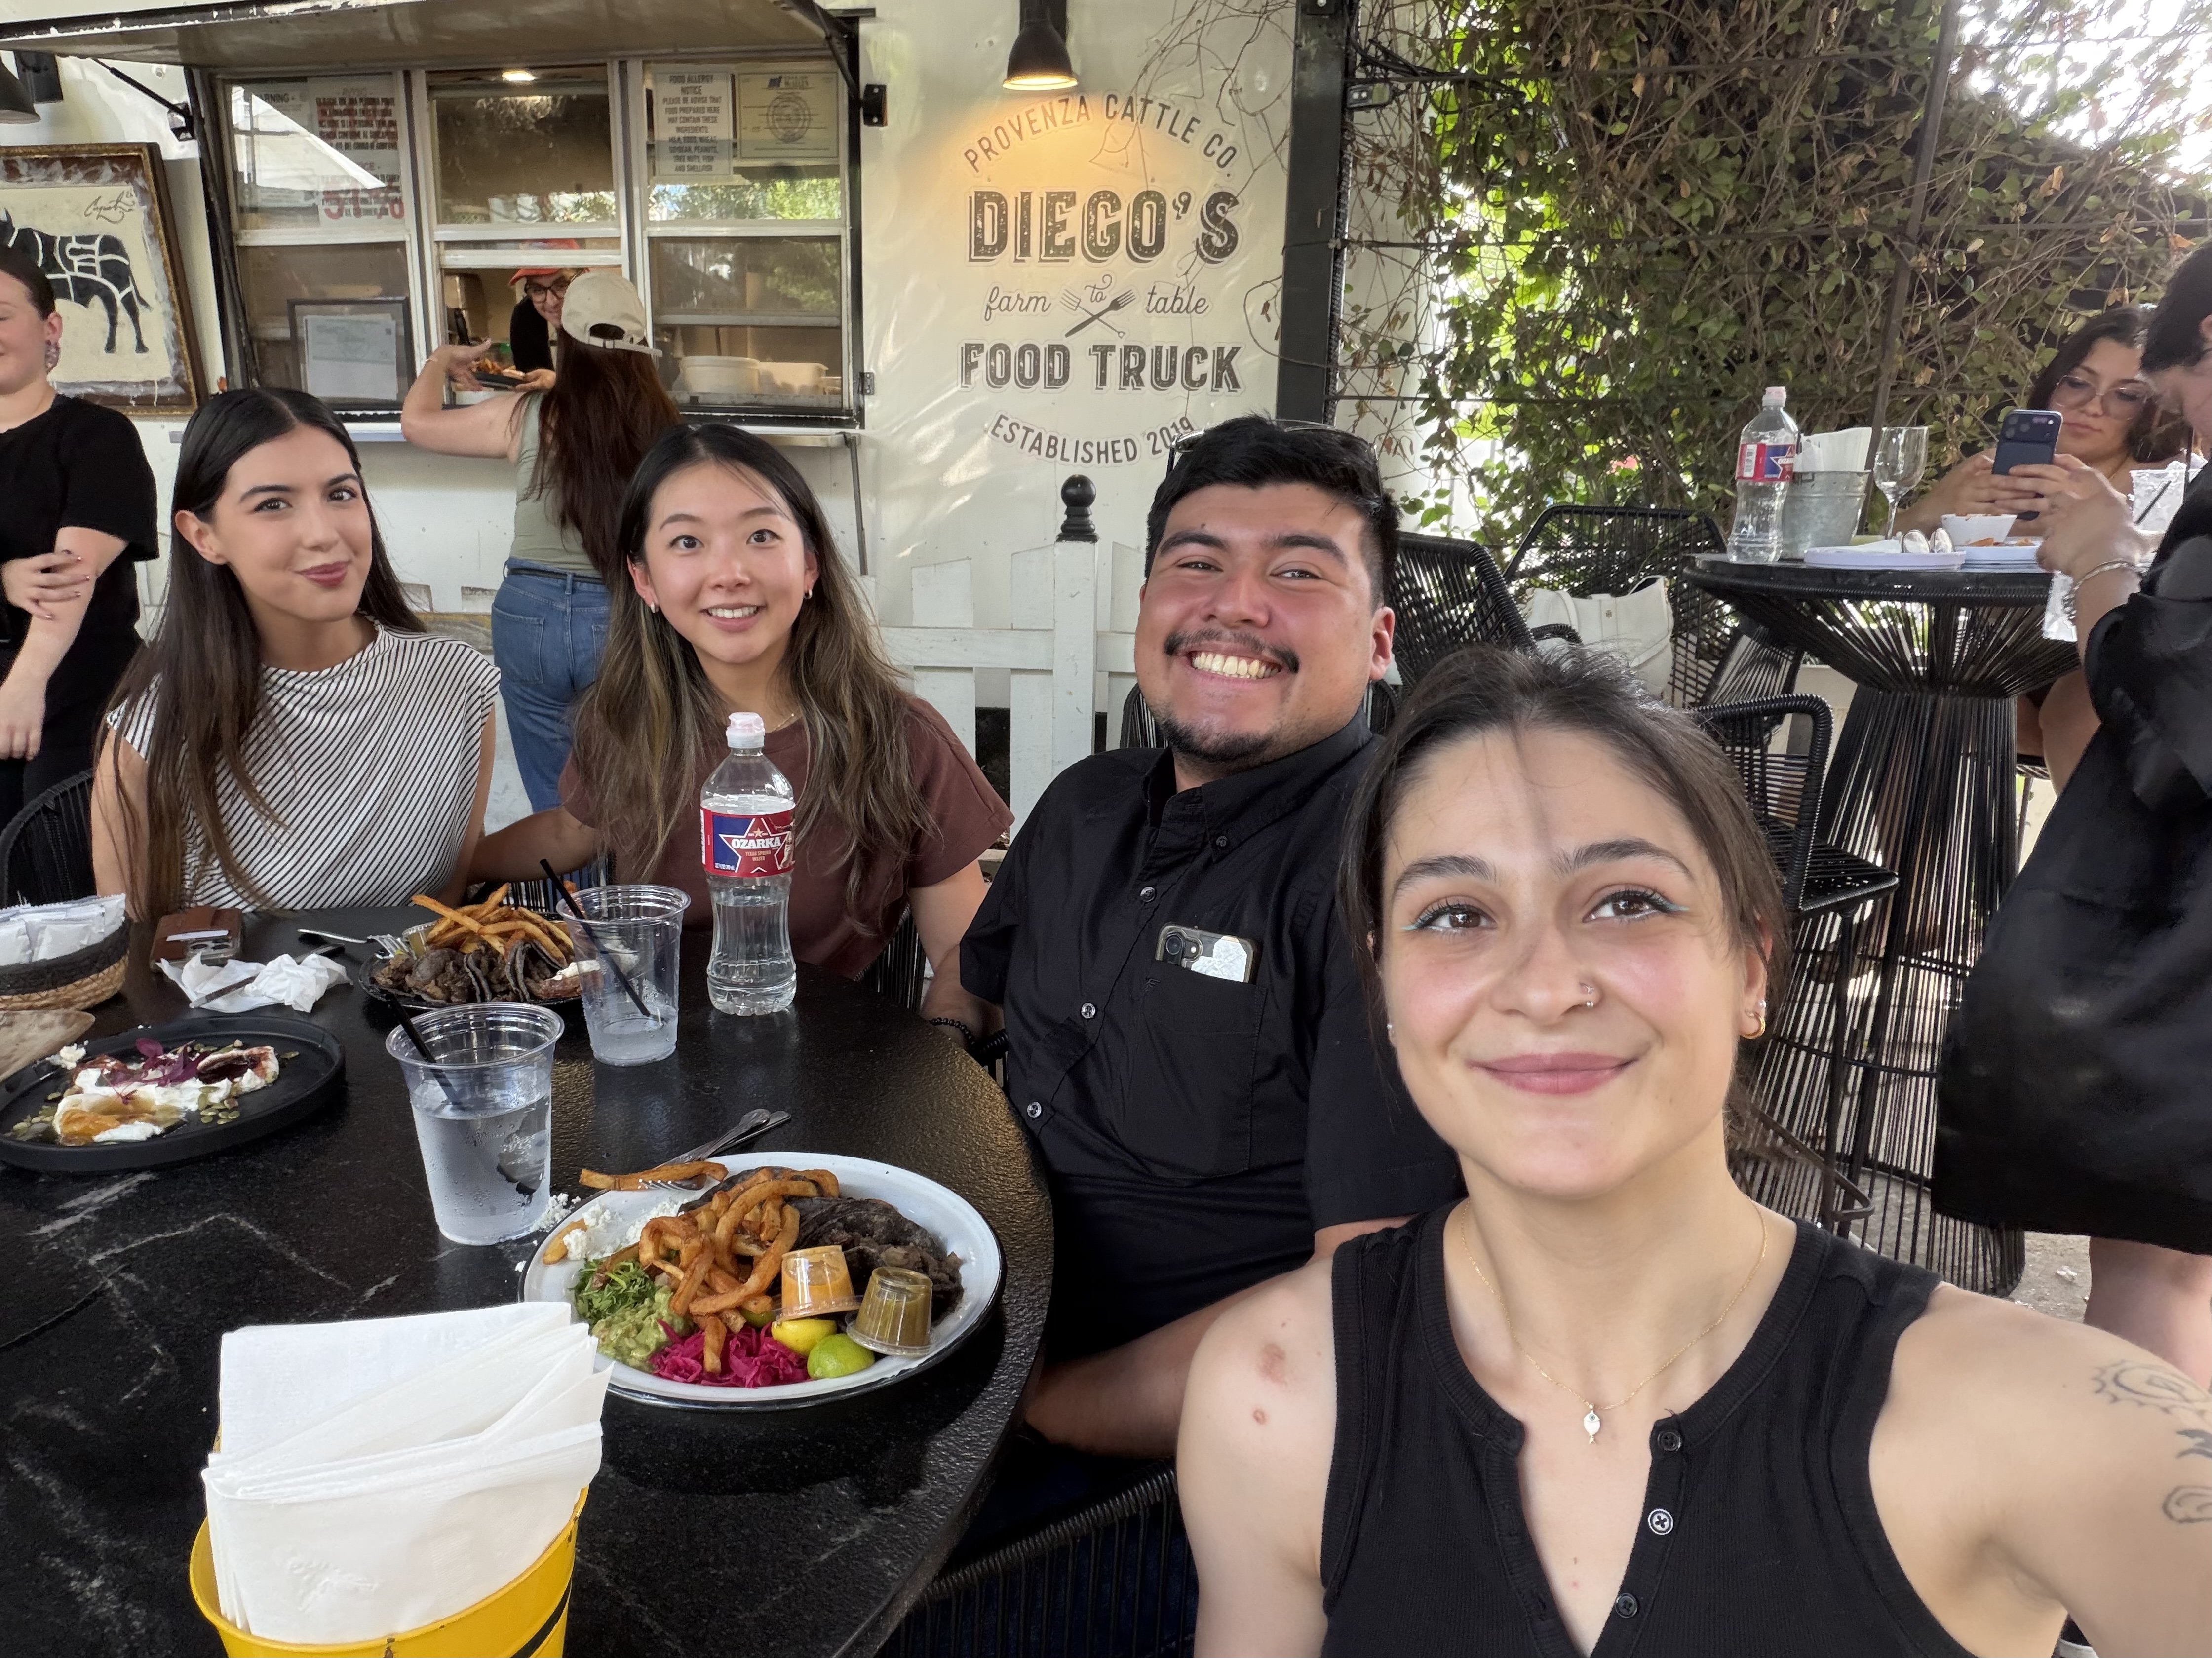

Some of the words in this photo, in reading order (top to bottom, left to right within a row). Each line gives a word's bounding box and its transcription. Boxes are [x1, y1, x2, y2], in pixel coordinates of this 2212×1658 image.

[670, 75, 685, 83] FOOD
[687, 75, 713, 83] ALLERGY
[681, 86, 701, 95] NOTICE
[964, 96, 1090, 173] PROVENZA
[1106, 94, 1200, 144] CATTLE
[1203, 134, 1237, 177] CO.
[968, 190, 1239, 264] DIEGO'S
[984, 286, 1051, 321] farm
[1084, 274, 1113, 303] to
[1145, 285, 1209, 314] table
[961, 343, 1070, 390] FOOD
[1089, 345, 1242, 392] TRUCK
[991, 414, 1137, 464] ESTABLISHED
[1146, 417, 1195, 456] 2019
[731, 836, 781, 849] OZARKA
